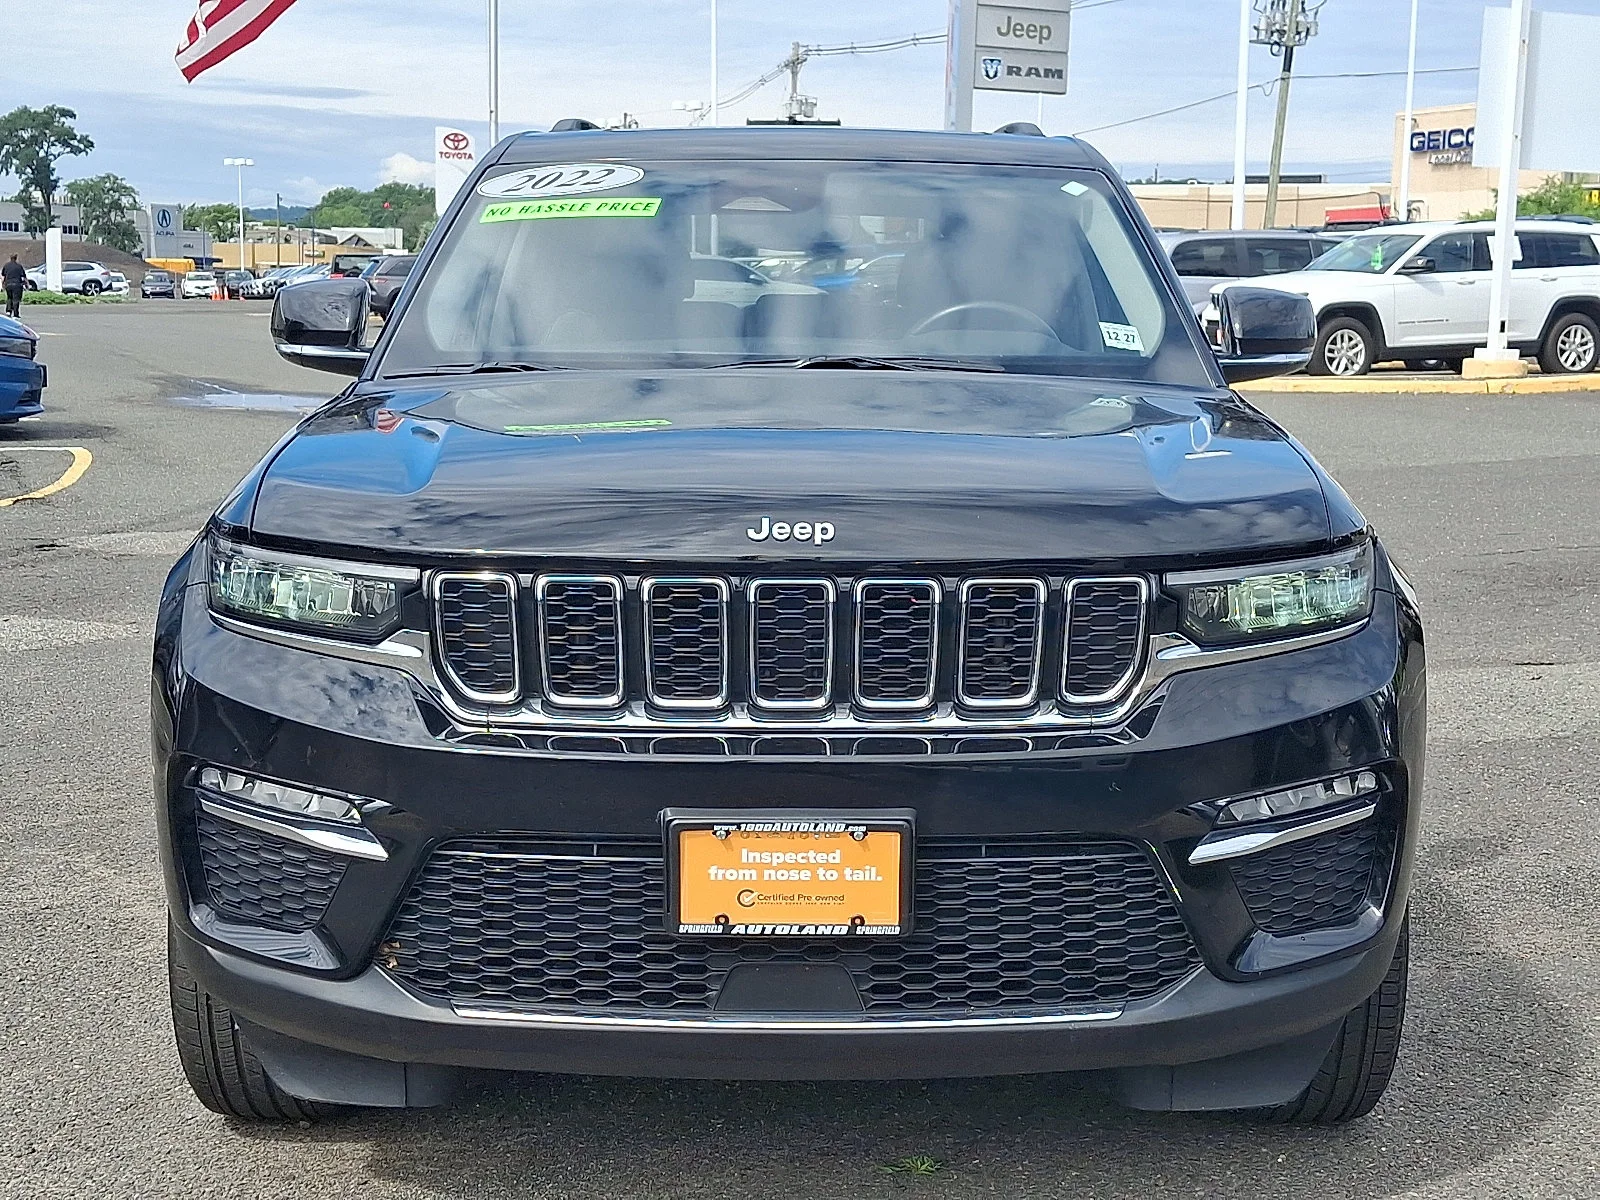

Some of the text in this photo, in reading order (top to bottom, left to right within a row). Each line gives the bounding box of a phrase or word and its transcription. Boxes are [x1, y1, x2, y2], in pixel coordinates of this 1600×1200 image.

[996, 16, 1052, 45] Jeep
[1006, 65, 1064, 80] RAM
[438, 151, 474, 160] TOYOTA
[501, 168, 616, 193] 2022
[486, 202, 656, 218] NO HASSLE PRICE
[1106, 330, 1136, 343] 12 27
[746, 516, 836, 547] Jeep
[740, 848, 841, 866] Inspected
[708, 865, 883, 881] from nose to tail.
[757, 893, 845, 902] Certified Pre owned
[678, 924, 901, 935] SPRINGFIELD AUTOLAND SPRINGFIELD
